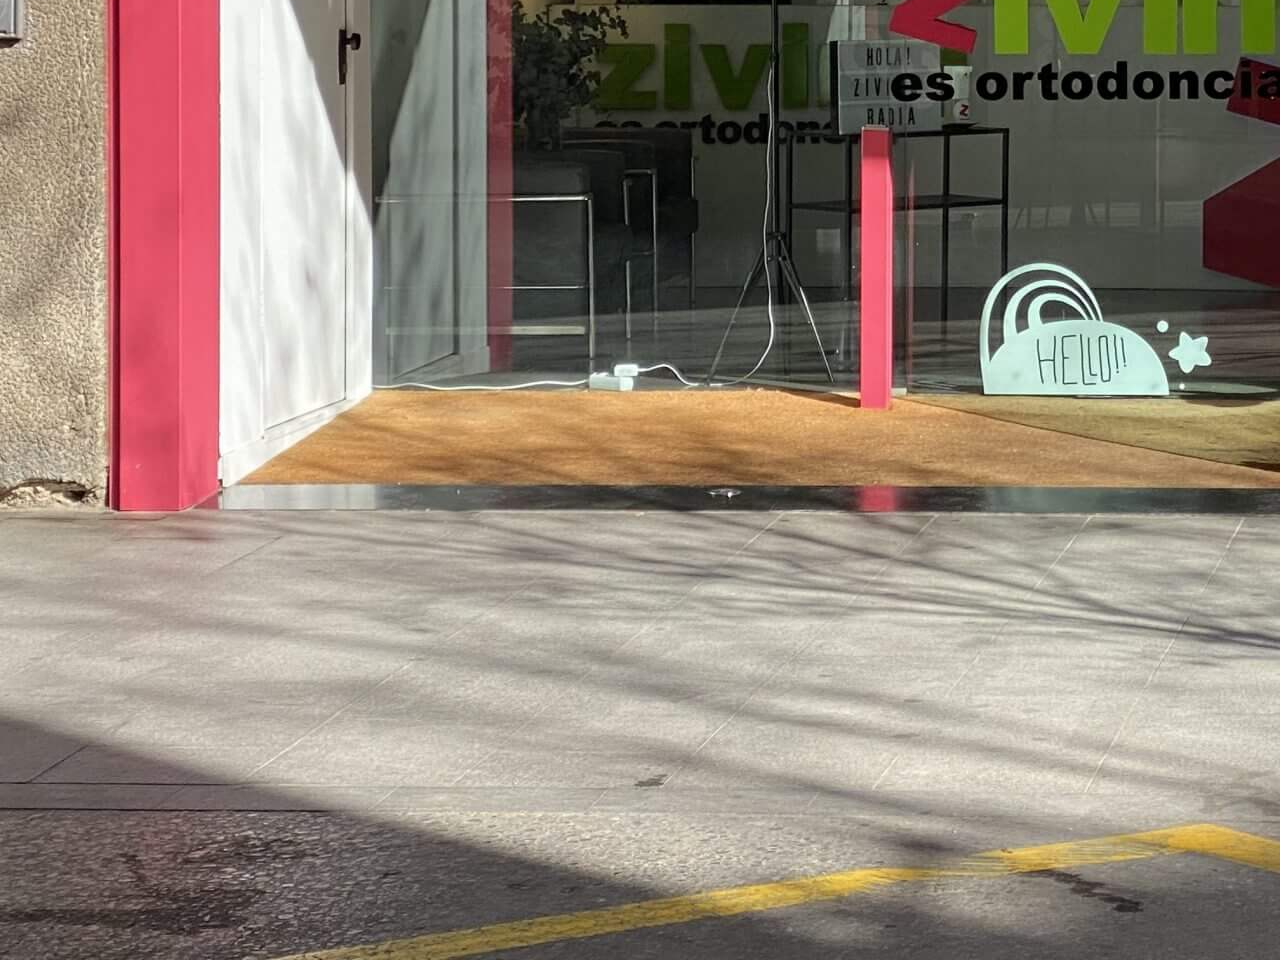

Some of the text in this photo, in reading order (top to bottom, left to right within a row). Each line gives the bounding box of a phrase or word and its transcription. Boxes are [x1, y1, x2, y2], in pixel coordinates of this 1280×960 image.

[866, 47, 911, 66] HOLA!
[891, 72, 955, 102] es
[1036, 333, 1127, 387] HELLO!!
